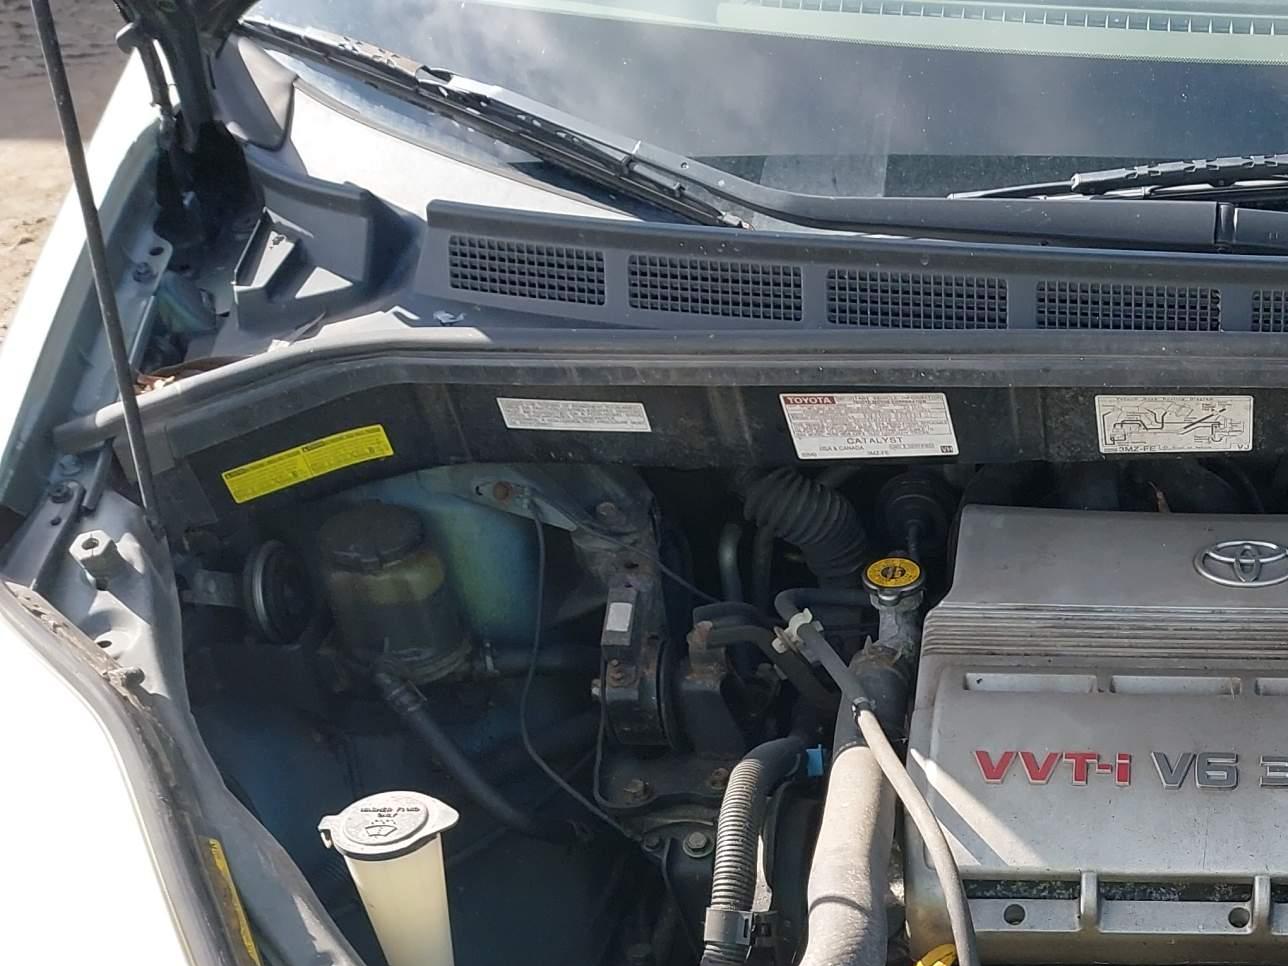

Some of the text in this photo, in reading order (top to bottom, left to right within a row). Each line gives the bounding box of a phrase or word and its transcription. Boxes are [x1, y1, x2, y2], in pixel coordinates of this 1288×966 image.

[846, 437, 903, 445] CATALYST
[975, 750, 1132, 786] VVT-i
[1151, 751, 1240, 790] V6
